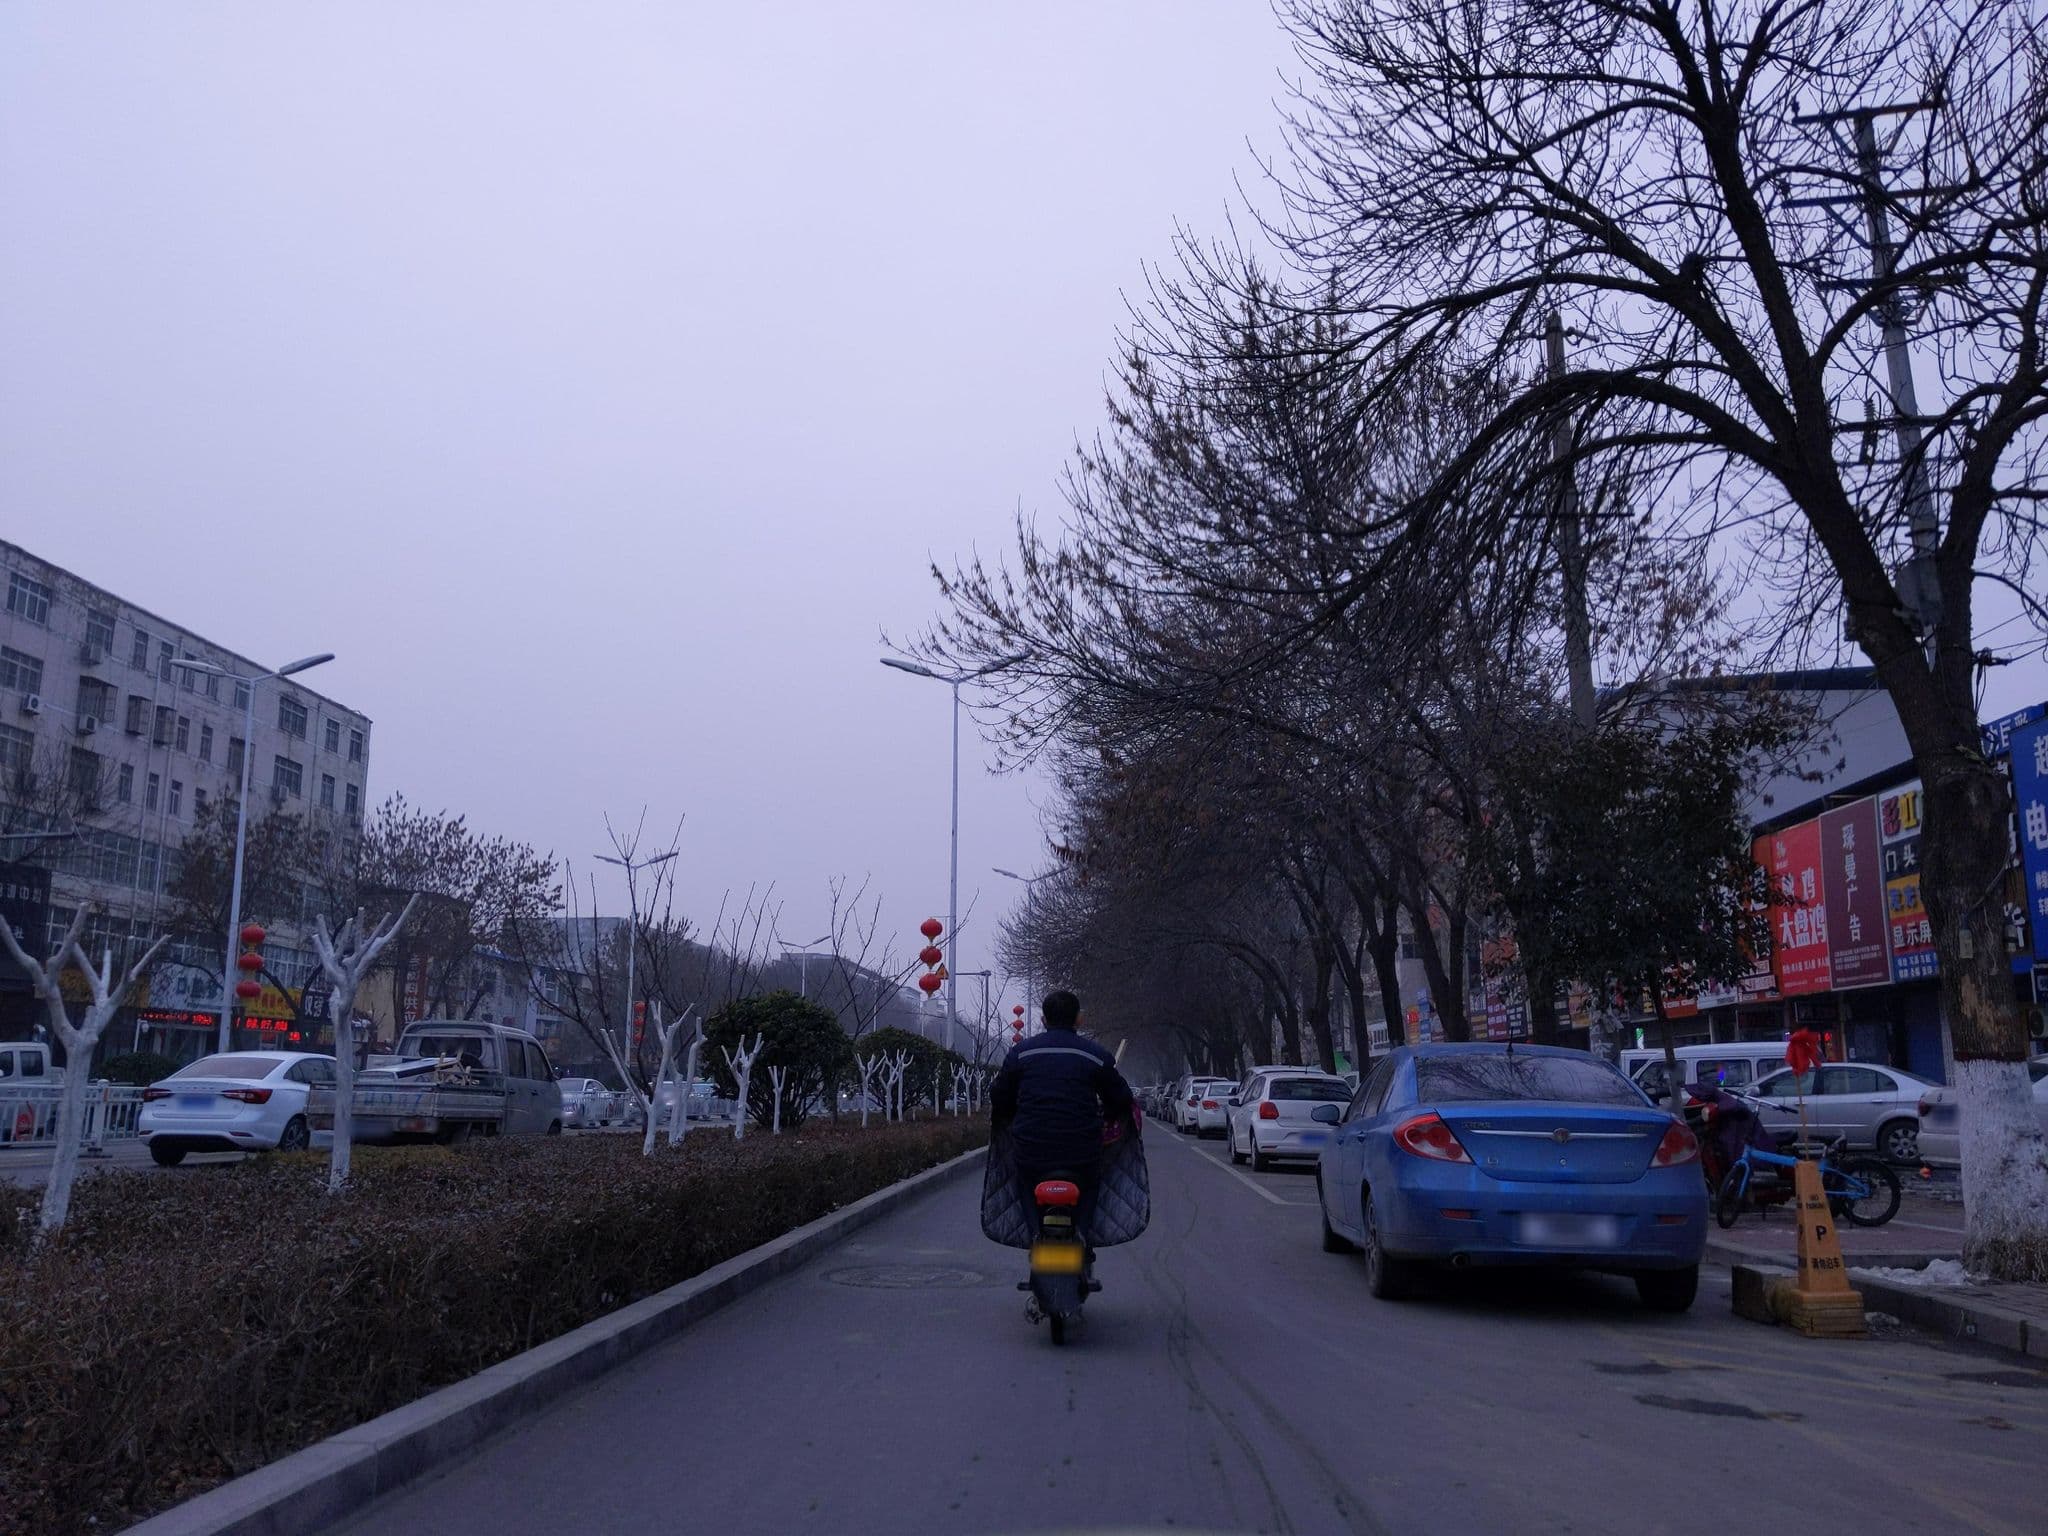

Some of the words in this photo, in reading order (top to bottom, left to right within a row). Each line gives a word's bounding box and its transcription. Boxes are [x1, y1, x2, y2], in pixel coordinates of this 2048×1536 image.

[1779, 903, 1828, 949] 大盘鸡
[1893, 918, 1932, 949] 显示屏
[1815, 1225, 1827, 1241] P
